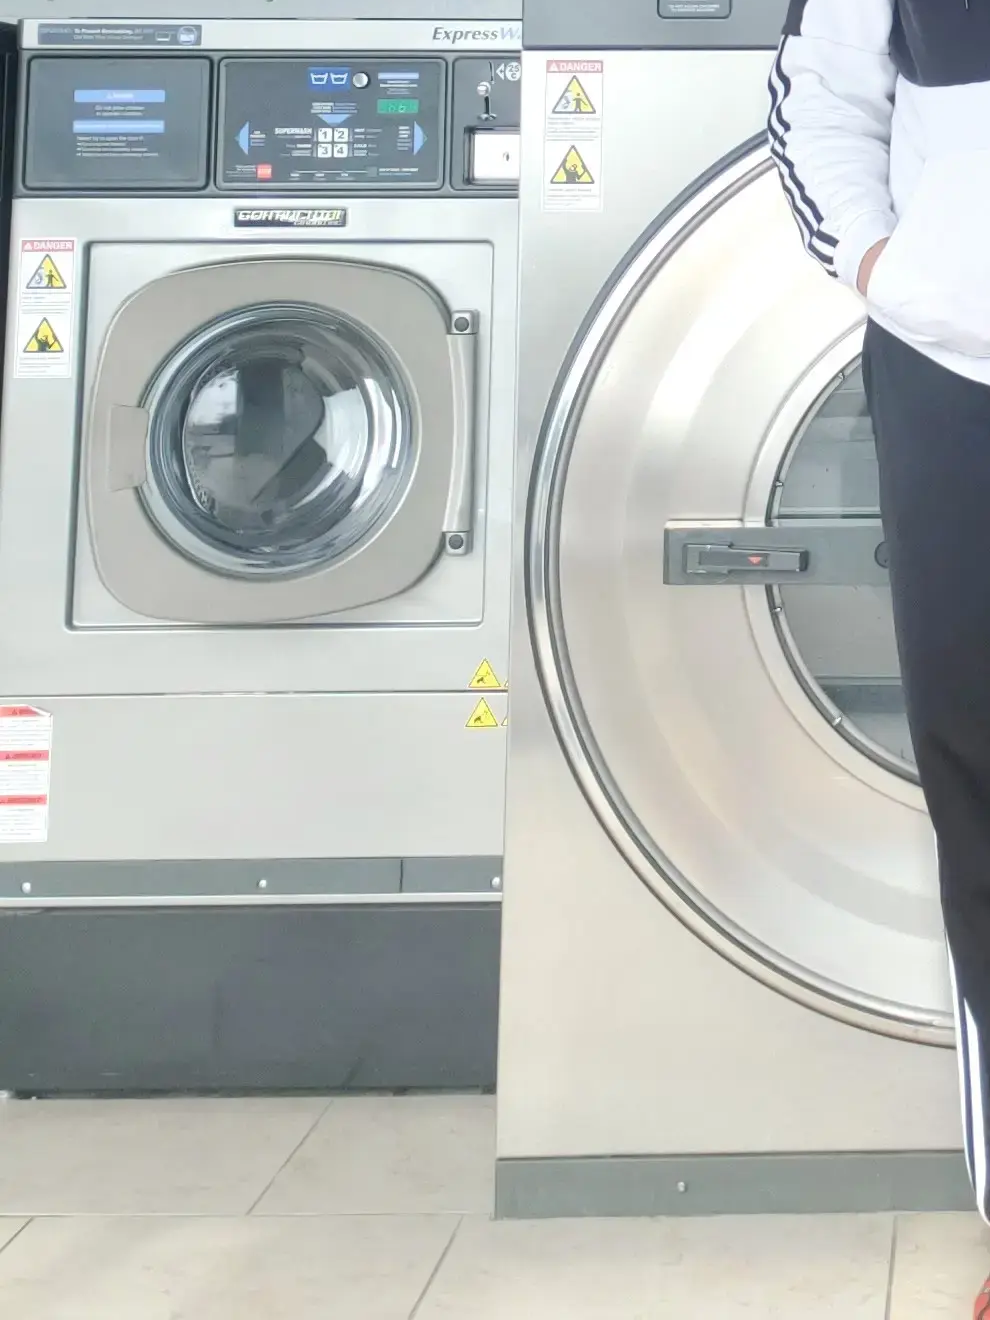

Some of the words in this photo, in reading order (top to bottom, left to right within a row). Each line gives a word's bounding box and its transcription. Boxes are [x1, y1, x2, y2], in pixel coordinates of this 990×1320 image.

[432, 26, 521, 45] ExpressW
[559, 61, 602, 72] DANGER
[322, 130, 328, 140] 1
[338, 130, 345, 140] 2
[321, 146, 329, 155] 3
[336, 146, 345, 155] 4
[33, 241, 74, 251] DANGER
